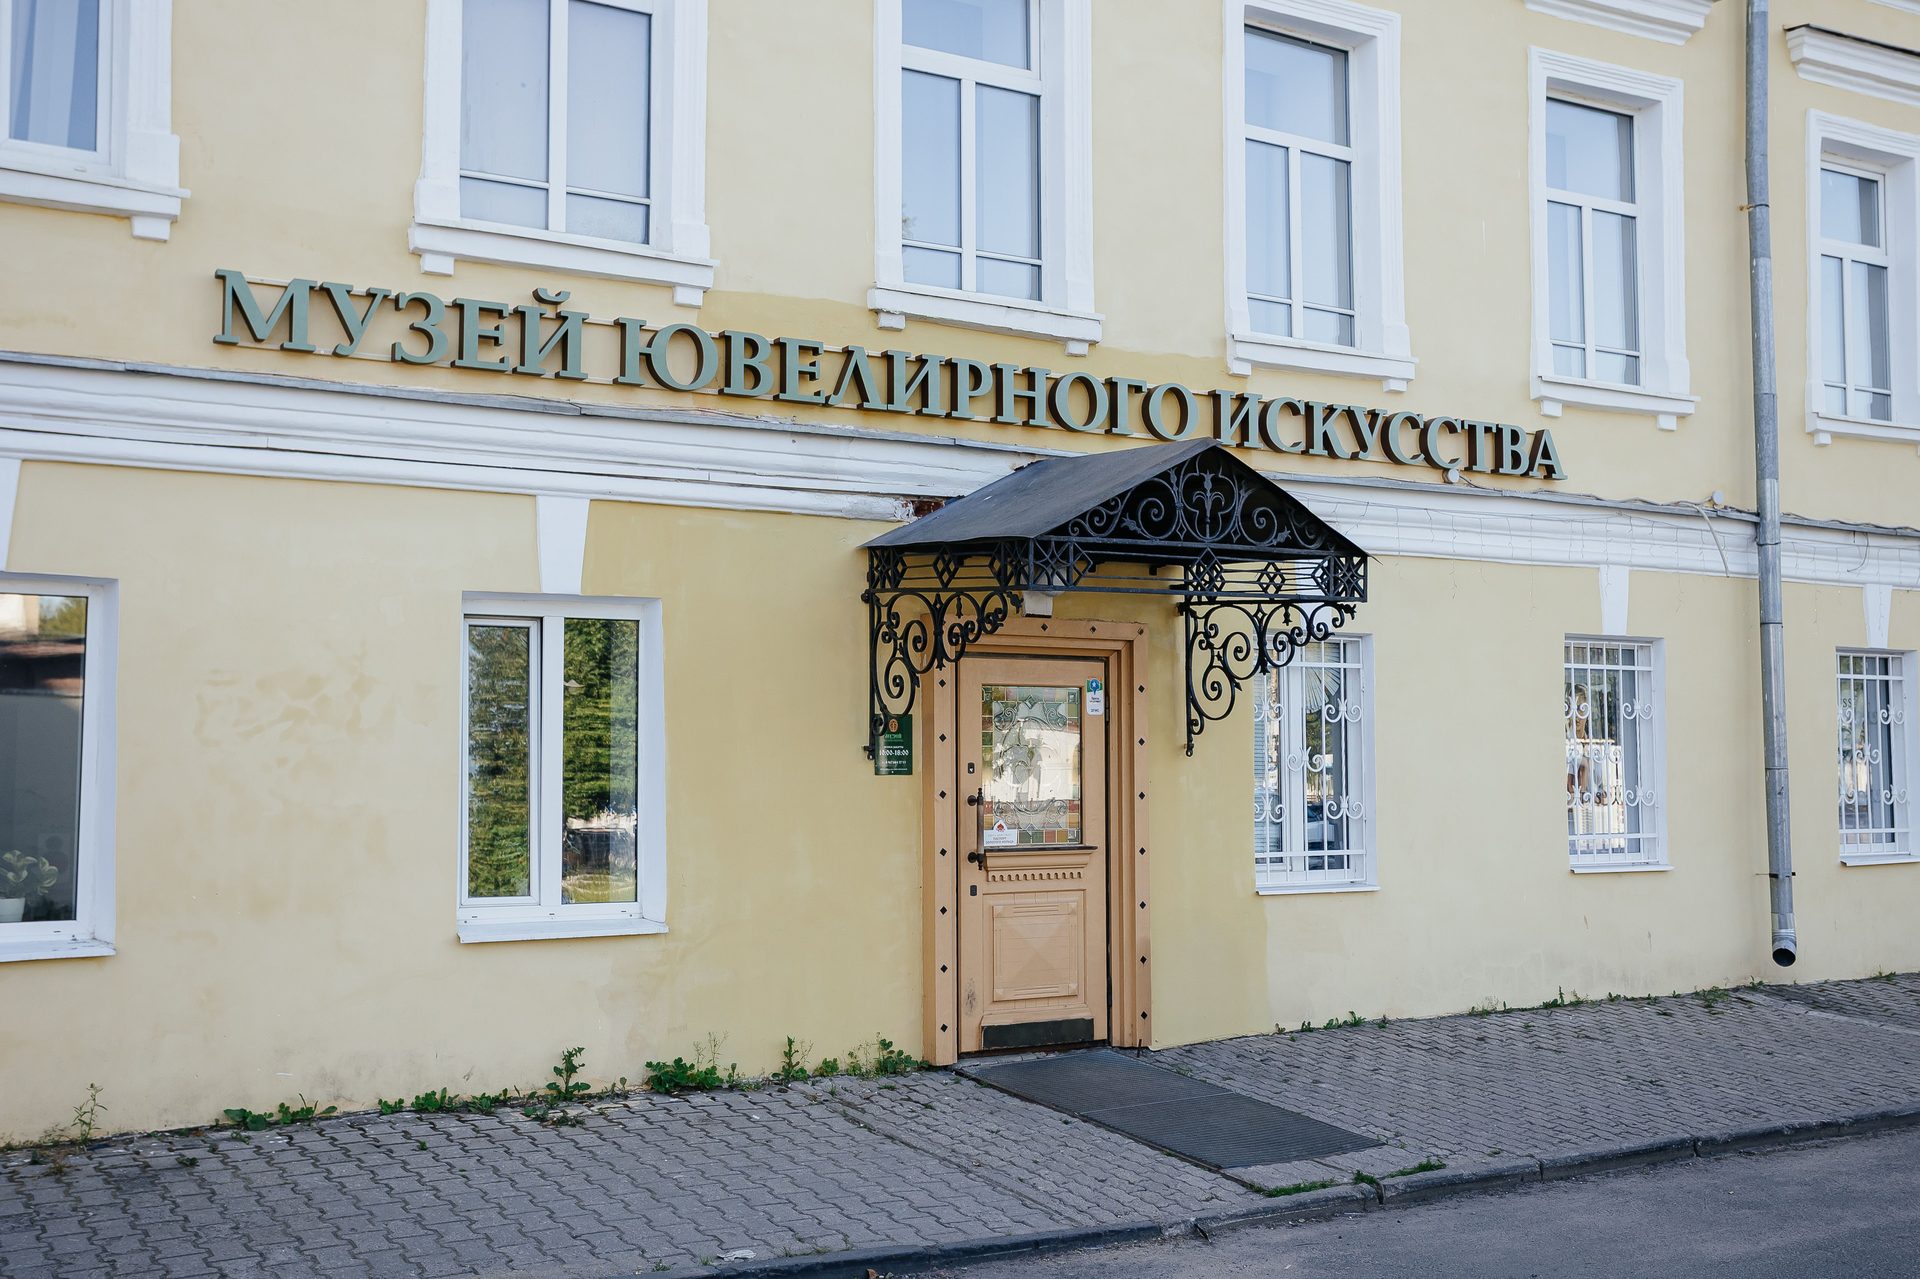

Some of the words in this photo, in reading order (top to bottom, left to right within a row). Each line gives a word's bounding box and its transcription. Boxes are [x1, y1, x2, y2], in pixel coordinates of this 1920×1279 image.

[213, 269, 590, 381] МУЗЕЙ
[612, 317, 1199, 441] ЮВЕЛИРНОГО
[1208, 389, 1568, 481] ИСКУССТВА
